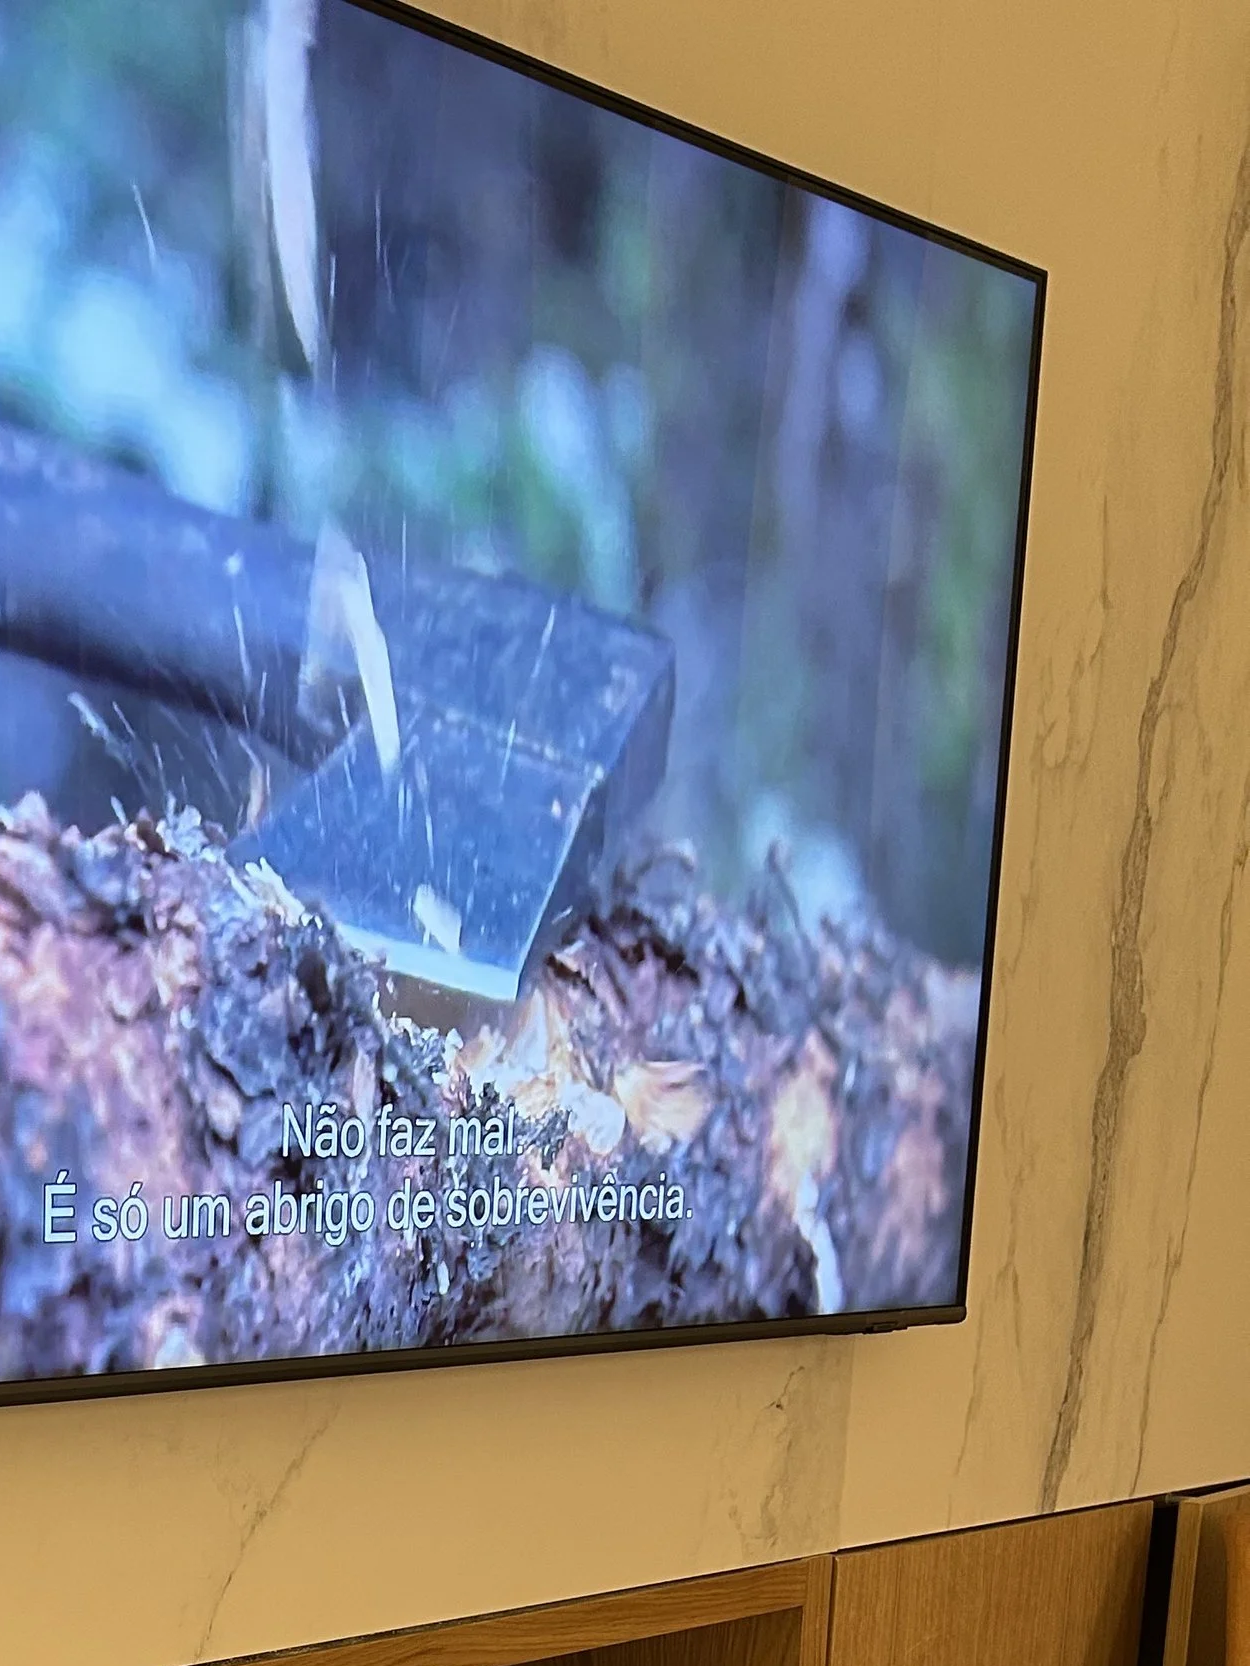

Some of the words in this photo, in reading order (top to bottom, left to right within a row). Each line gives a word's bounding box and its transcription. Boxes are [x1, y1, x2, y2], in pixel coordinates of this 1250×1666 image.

[282, 1102, 365, 1158] Não
[377, 1102, 437, 1157] faz
[448, 1104, 524, 1156] mal.
[43, 1170, 78, 1243] É
[91, 1181, 149, 1241] só
[163, 1193, 231, 1239] um
[245, 1178, 375, 1247] abrigo
[387, 1177, 436, 1230] de
[446, 1172, 694, 1227] sobrevivência.
